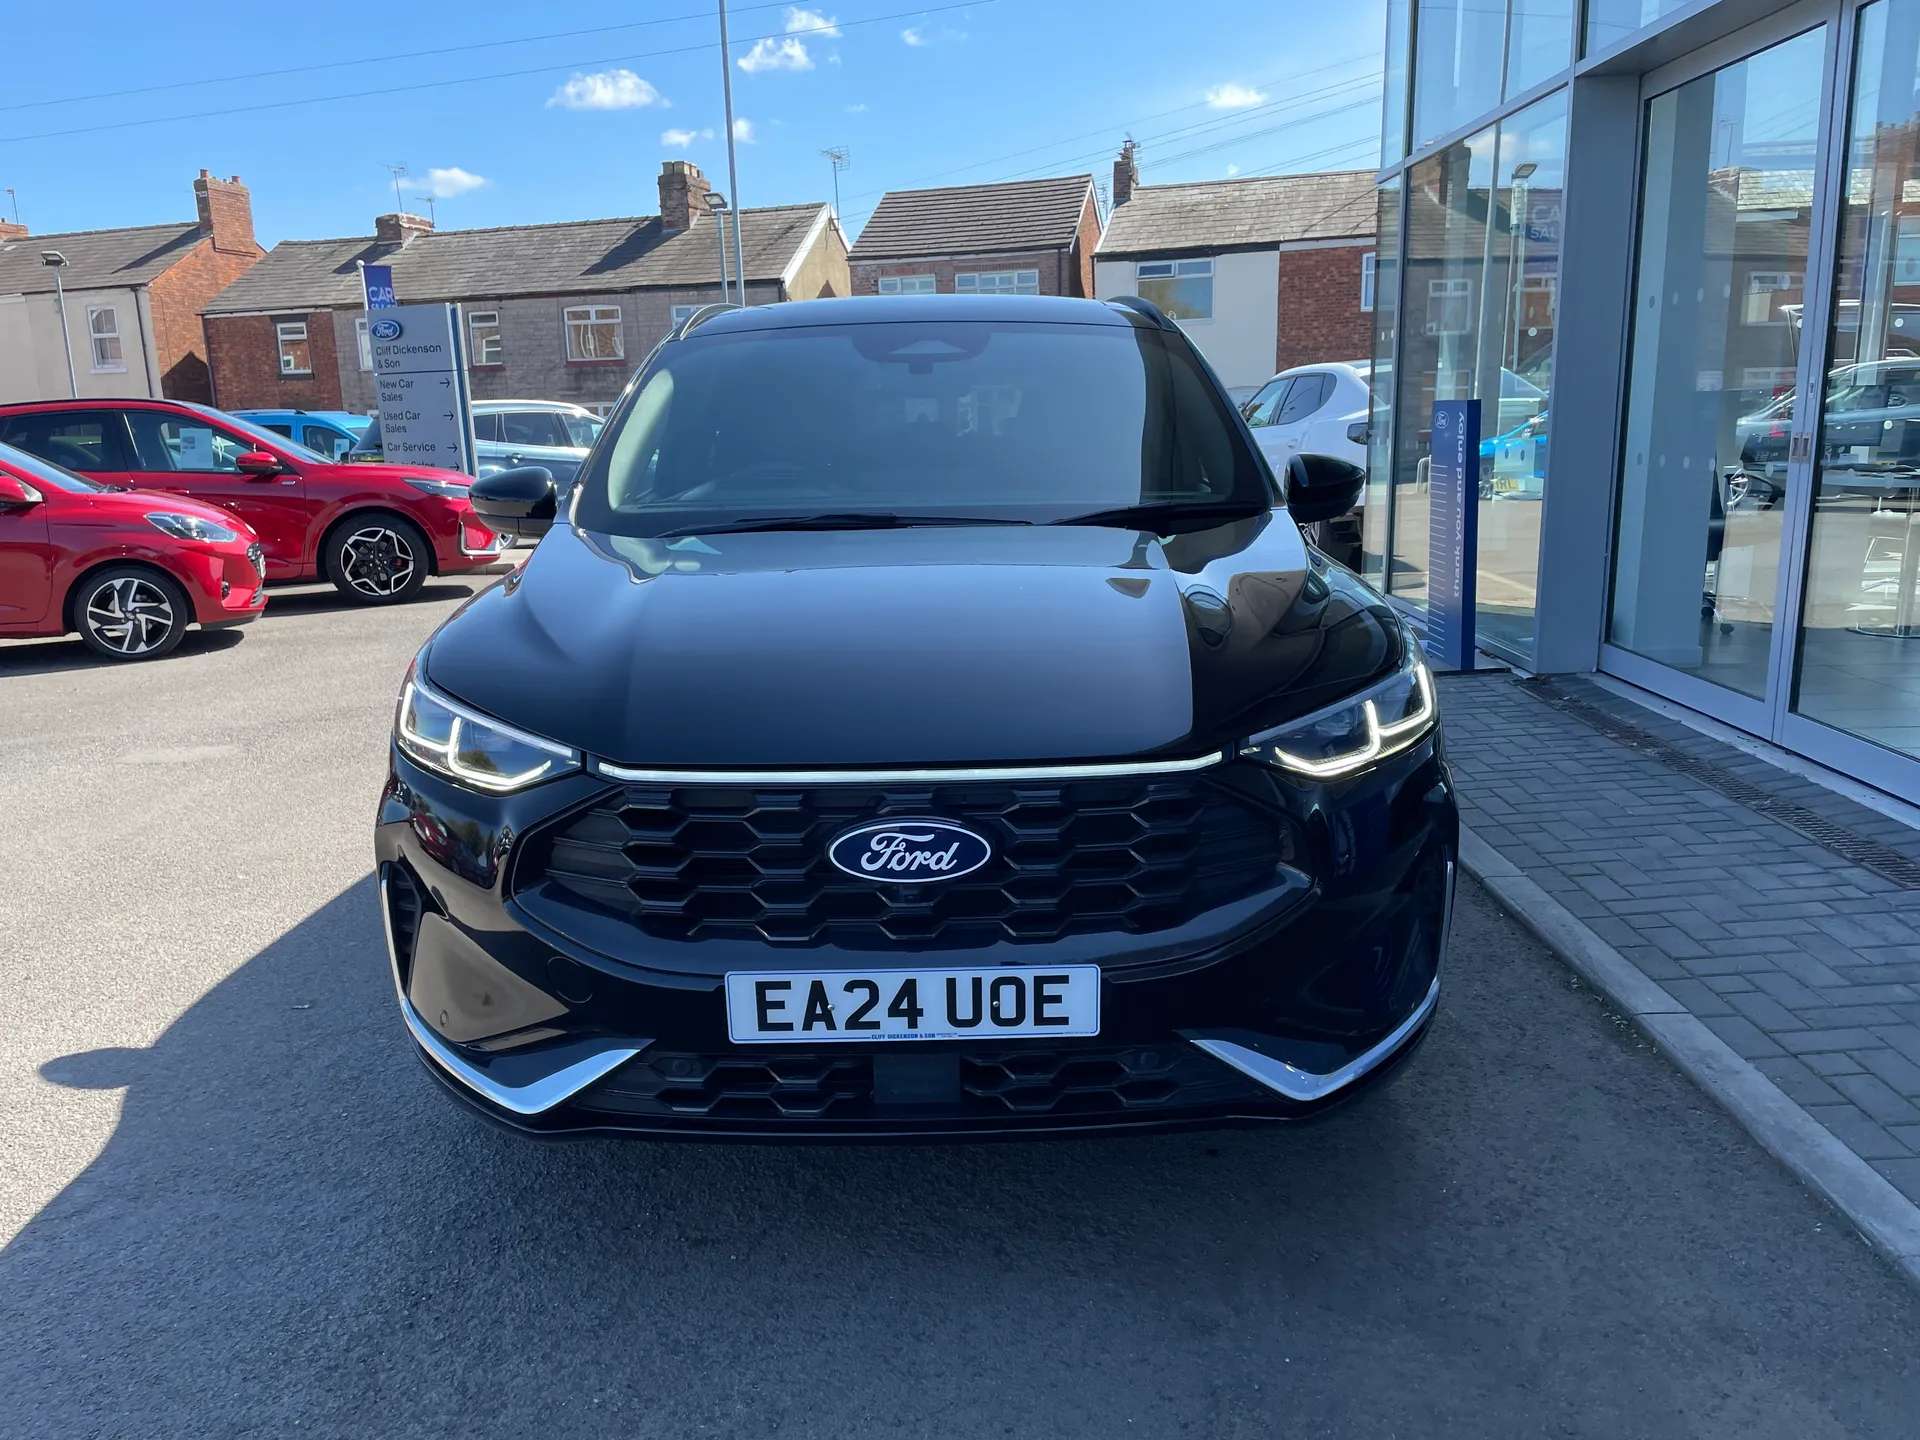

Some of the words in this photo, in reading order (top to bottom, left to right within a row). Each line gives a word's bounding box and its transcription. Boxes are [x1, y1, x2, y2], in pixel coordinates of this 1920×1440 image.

[368, 286, 395, 302] CAR
[375, 322, 394, 337] Ford
[376, 345, 391, 356] Cliff
[392, 343, 442, 355] Dickenson
[377, 360, 383, 369] &
[384, 359, 400, 369] Son
[380, 379, 398, 389] New
[399, 378, 414, 389] Car
[381, 392, 403, 401] Sales
[384, 411, 404, 420] Used
[405, 410, 421, 420] Car
[385, 423, 407, 433] Sales
[1457, 411, 1465, 464] enjoy
[388, 442, 401, 451] Car
[402, 442, 436, 451] Service
[860, 832, 960, 871] Ford
[754, 978, 924, 1032] EA24
[945, 975, 1070, 1029] UOE
